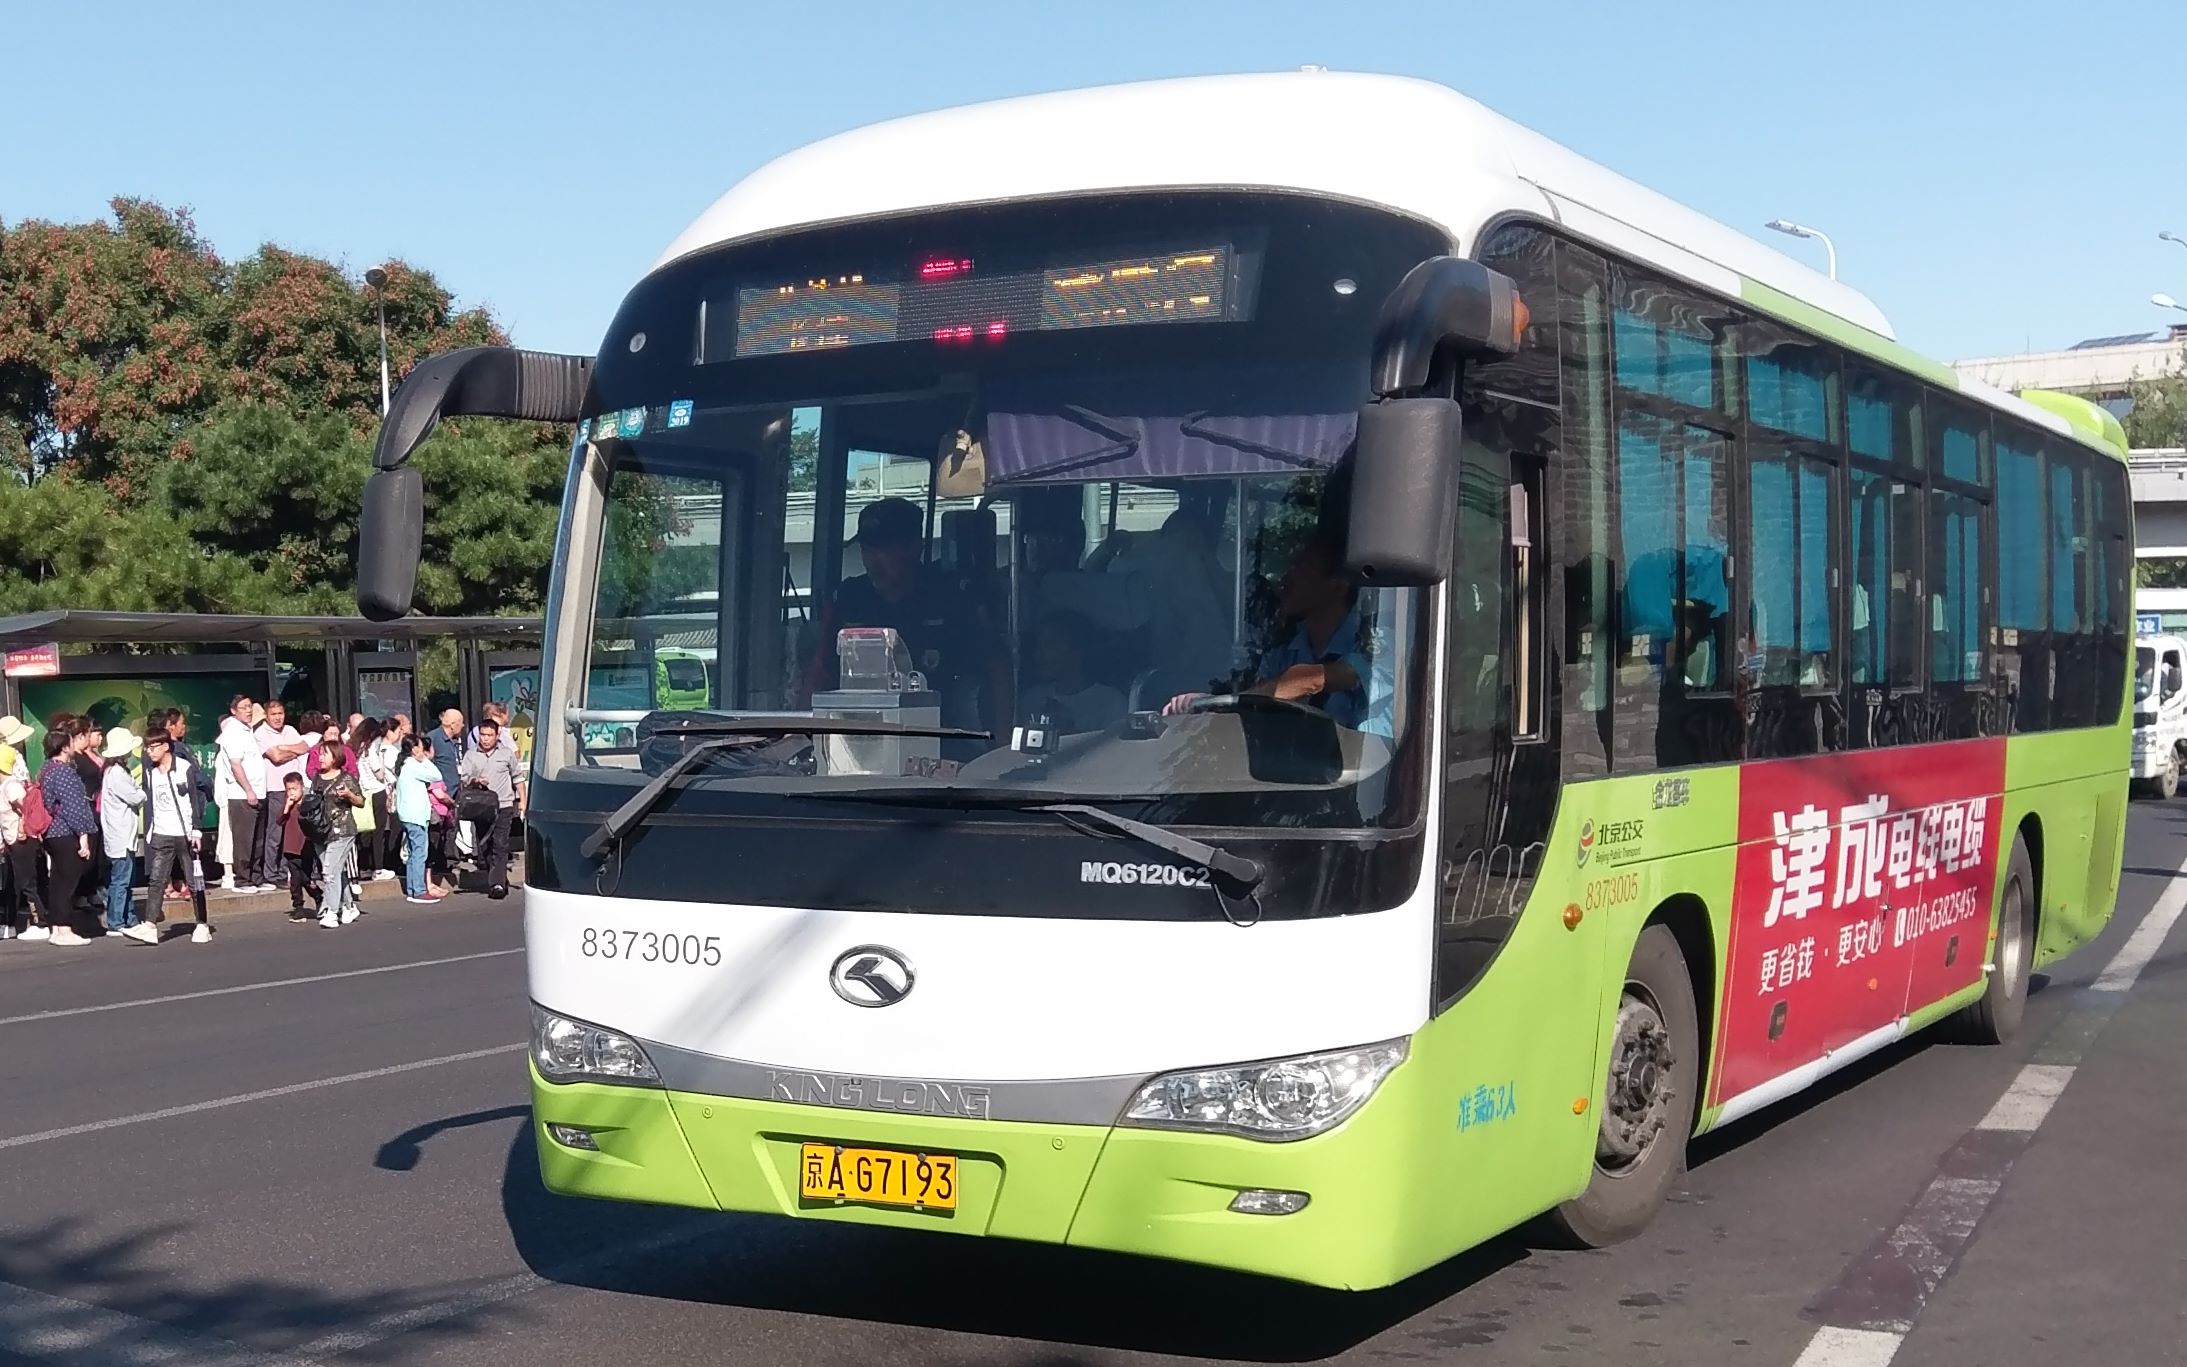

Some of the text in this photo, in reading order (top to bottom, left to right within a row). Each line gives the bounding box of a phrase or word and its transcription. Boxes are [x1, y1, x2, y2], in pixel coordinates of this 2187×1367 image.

[1598, 819, 1643, 846] 北京公交
[1080, 861, 1212, 888] MQ6120C2
[1585, 872, 1638, 911] 8373005
[581, 927, 722, 967] 8373005
[1758, 936, 1815, 995] 更省钱
[1906, 886, 1977, 941] 010-63825455
